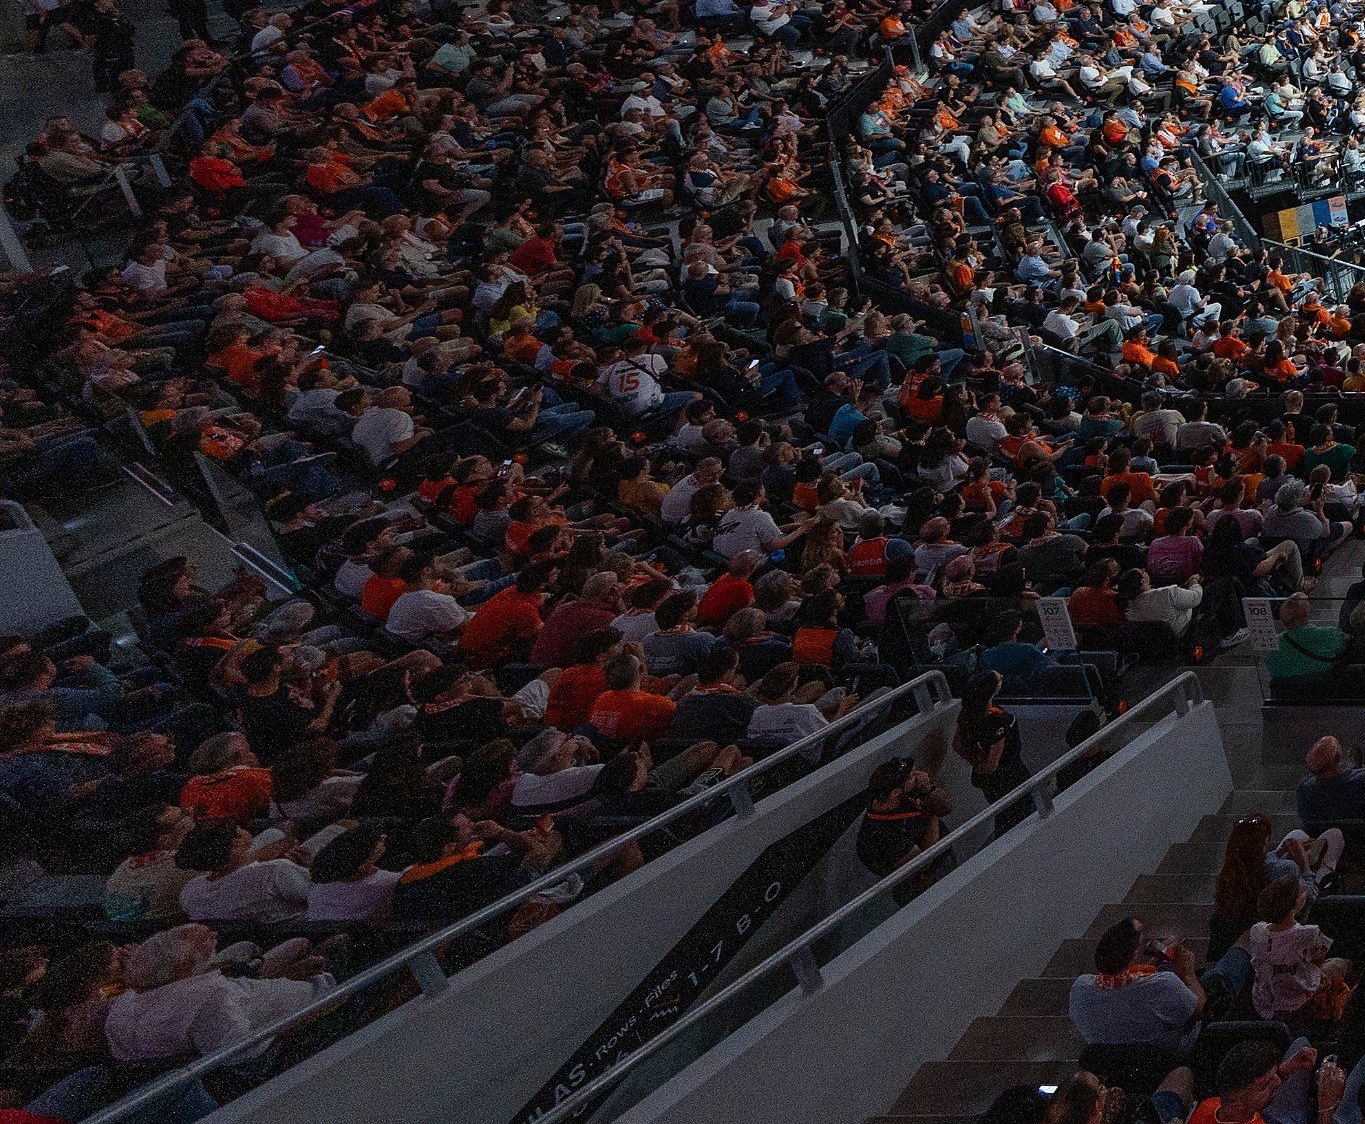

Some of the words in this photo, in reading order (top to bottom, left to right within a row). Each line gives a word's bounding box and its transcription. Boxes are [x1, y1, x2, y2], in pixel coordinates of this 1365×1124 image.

[619, 372, 639, 392] 15
[1042, 606, 1060, 615] 107
[1249, 606, 1266, 615] 108
